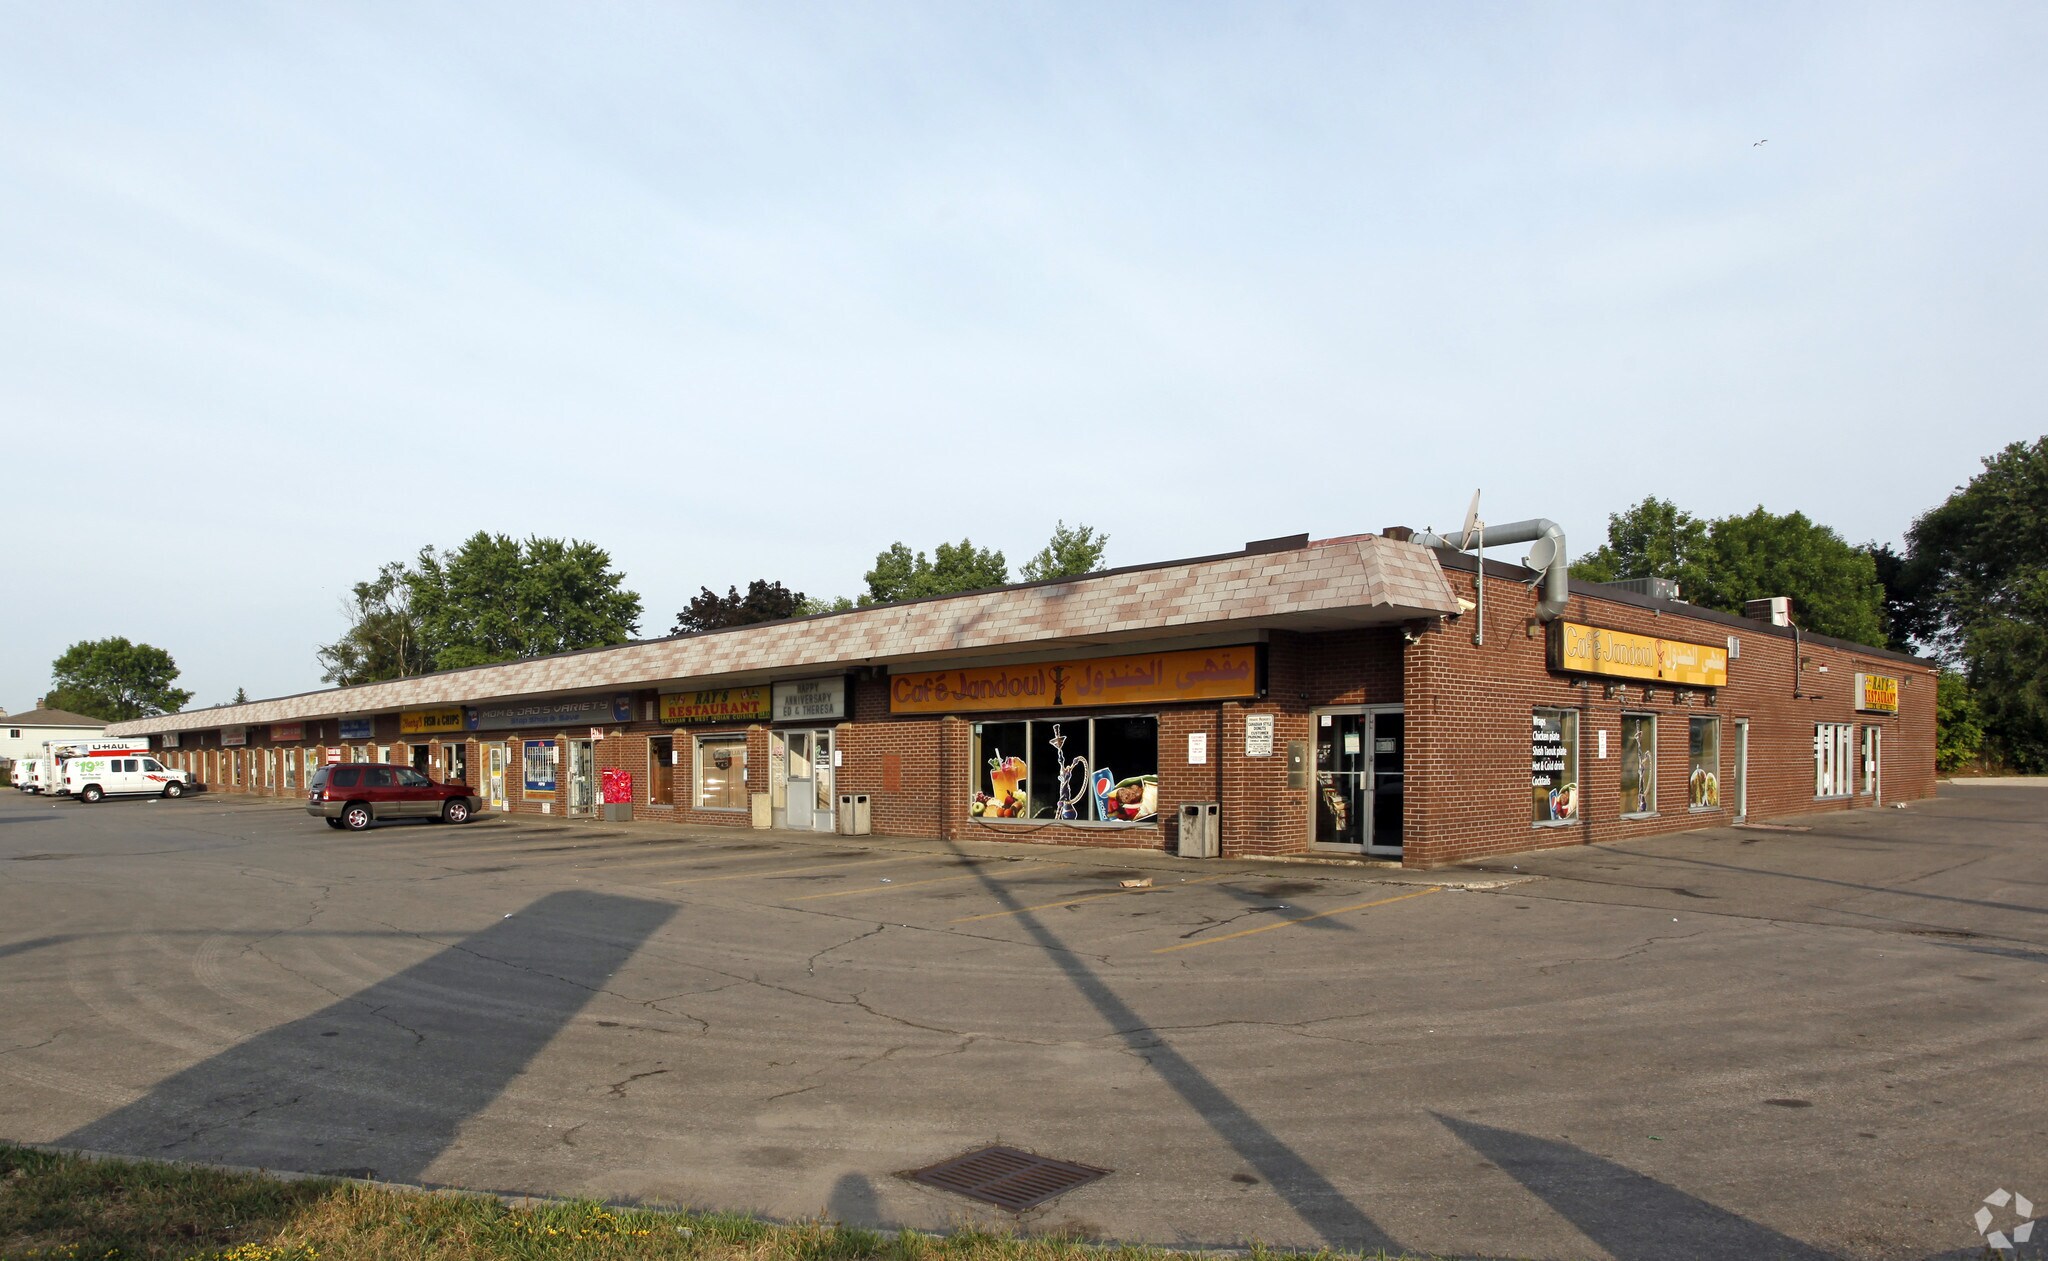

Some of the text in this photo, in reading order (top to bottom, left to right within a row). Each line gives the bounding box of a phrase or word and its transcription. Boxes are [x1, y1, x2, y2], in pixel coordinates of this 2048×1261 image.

[1564, 626, 1653, 668] Café Jandoul
[1075, 653, 1250, 696] مقهى الجندول
[797, 682, 819, 693] HAPPY
[893, 669, 1046, 704] Café Jandoul
[695, 689, 729, 704] RAY'S
[785, 693, 832, 706] ANNIVERSARY
[517, 704, 551, 716] DAD'S
[554, 701, 609, 712] VARIETY
[668, 701, 760, 717] RESTAURANT
[783, 706, 792, 716] ED
[803, 704, 834, 715] THERESA
[424, 716, 436, 726] FISH
[442, 714, 460, 726] CHIPS
[1533, 716, 1546, 728] Wraps
[1532, 731, 1560, 742] Chicken plate
[1532, 746, 1567, 757] Shish Taouk plate
[1532, 761, 1540, 771] Hot
[1545, 761, 1554, 771] Cold
[1555, 761, 1565, 771] drink
[1532, 775, 1551, 786] Cocktails
